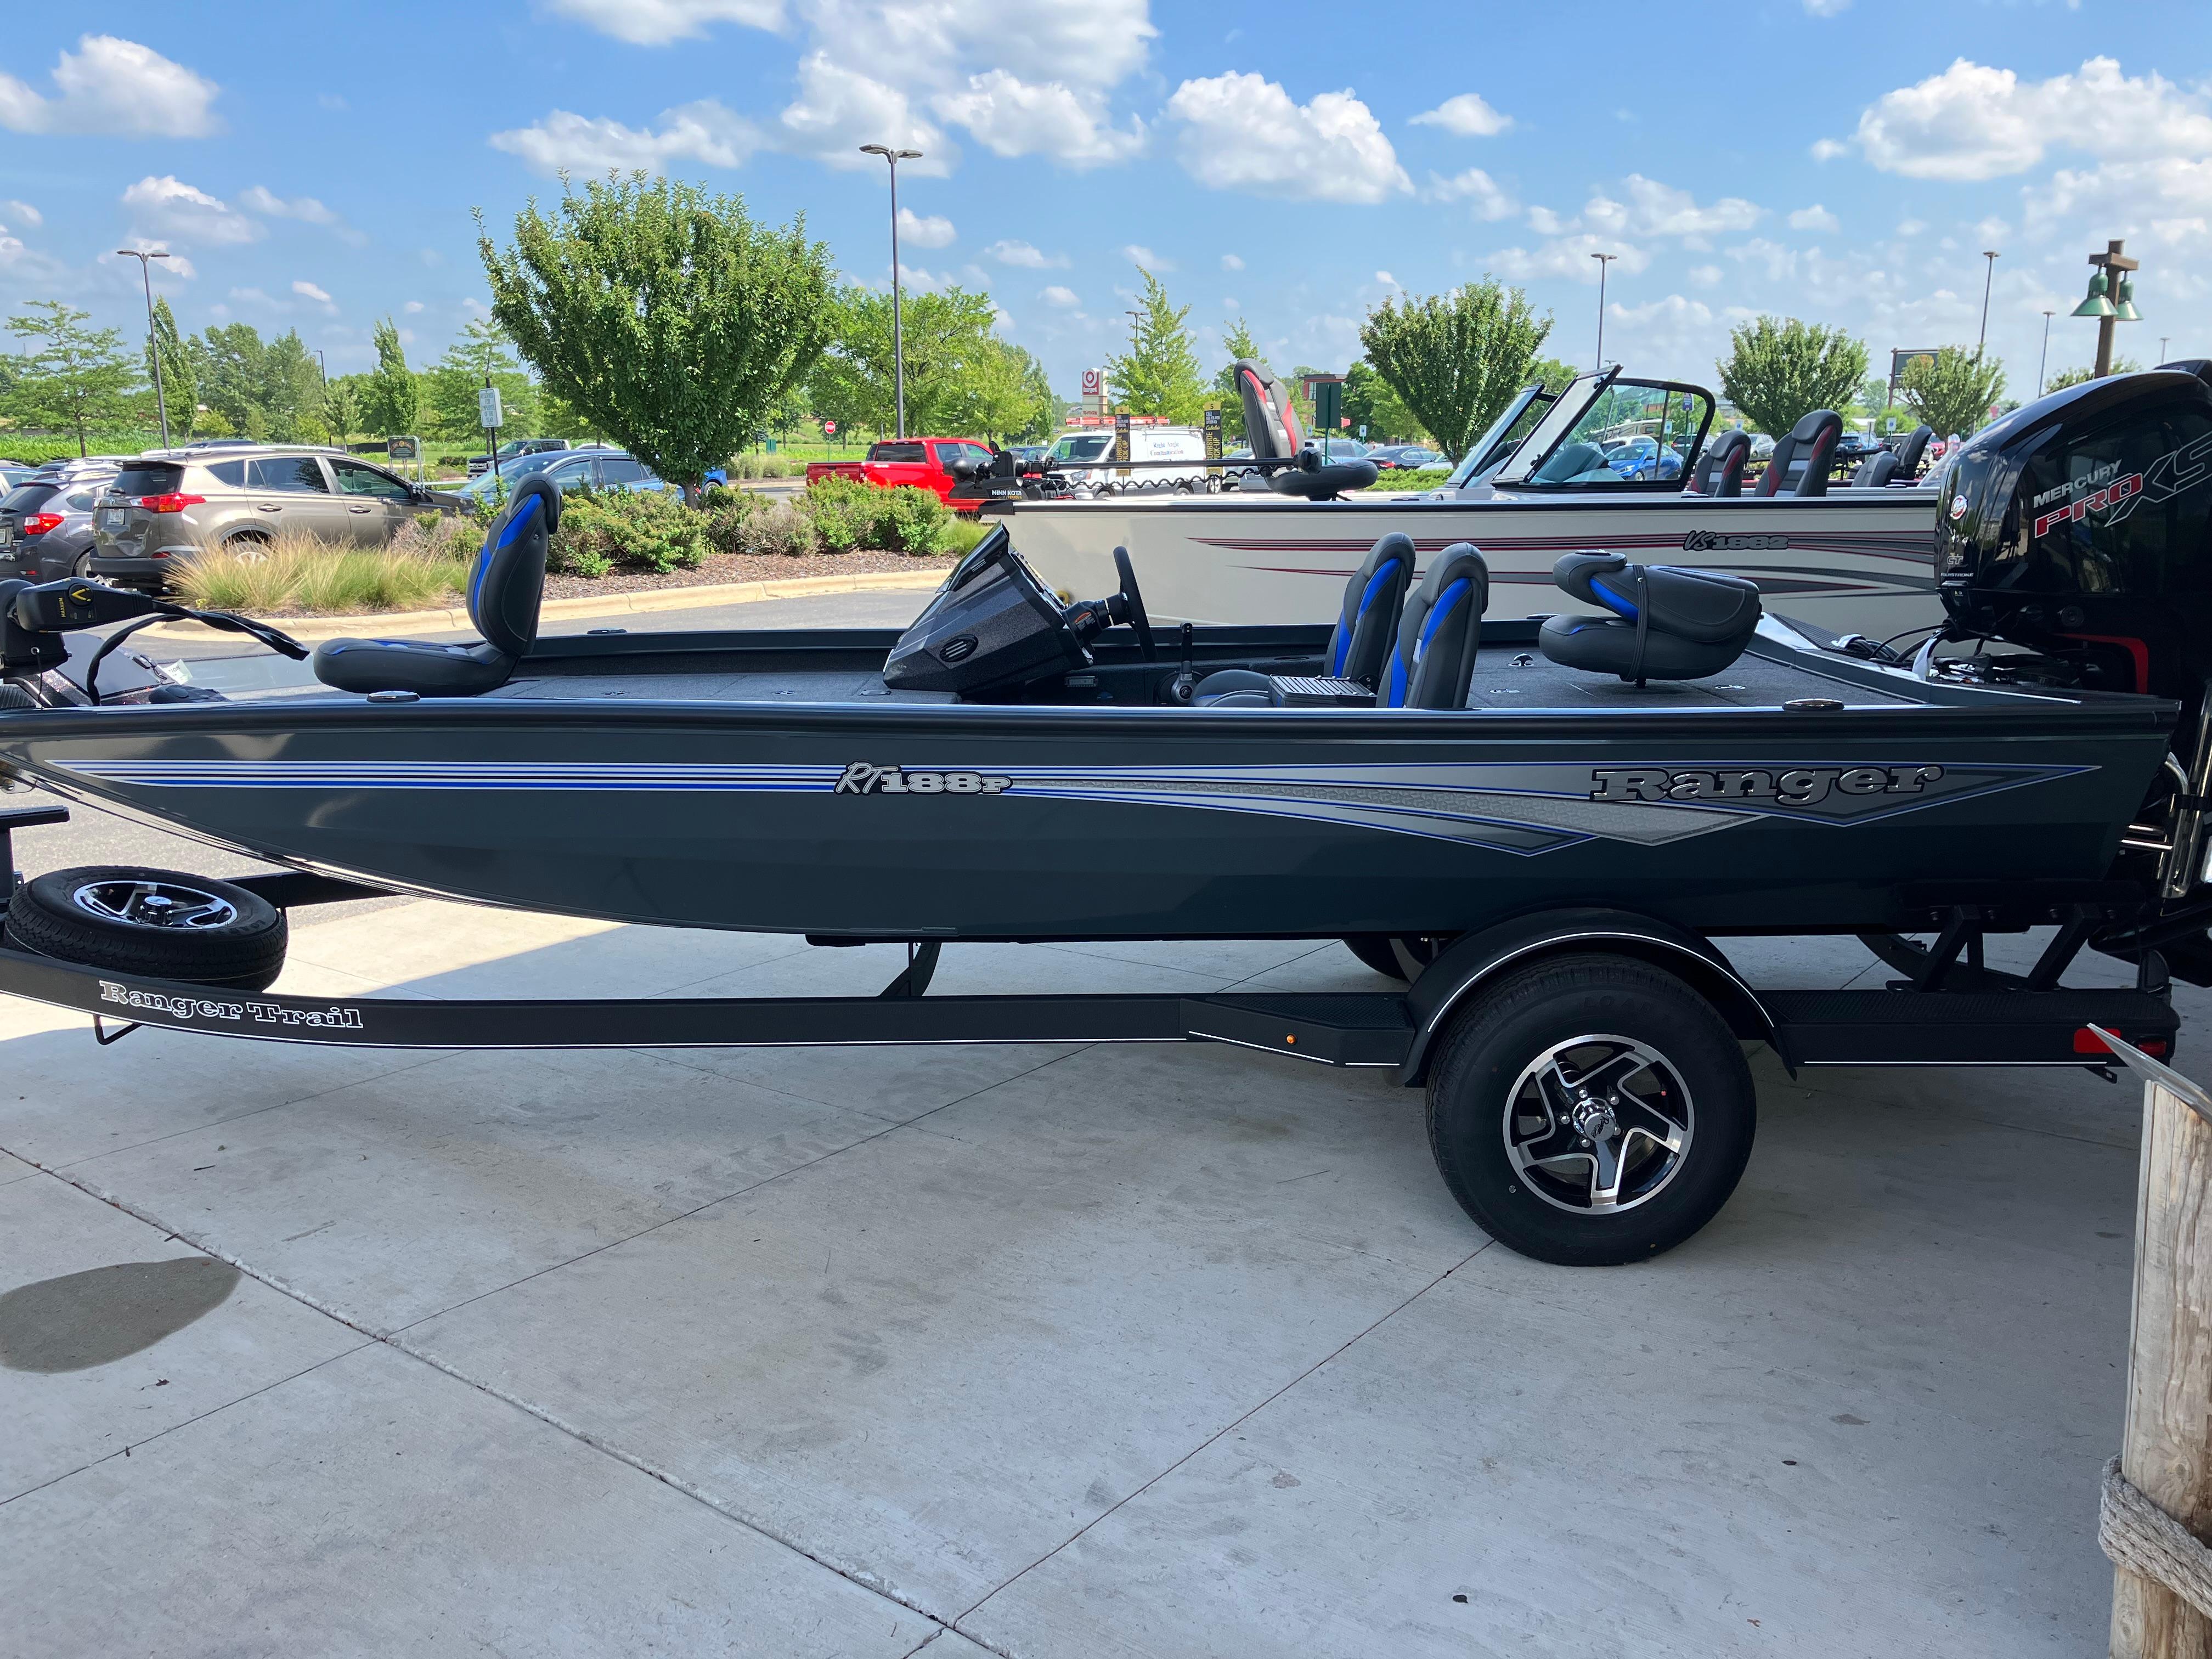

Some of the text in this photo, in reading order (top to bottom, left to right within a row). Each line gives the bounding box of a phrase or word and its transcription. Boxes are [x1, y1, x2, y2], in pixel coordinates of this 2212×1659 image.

[2033, 459, 2122, 508] MERCURY
[2034, 473, 2143, 538] PRO
[1590, 765, 1945, 806] Ranger
[99, 980, 364, 1029] Ranger Trail
